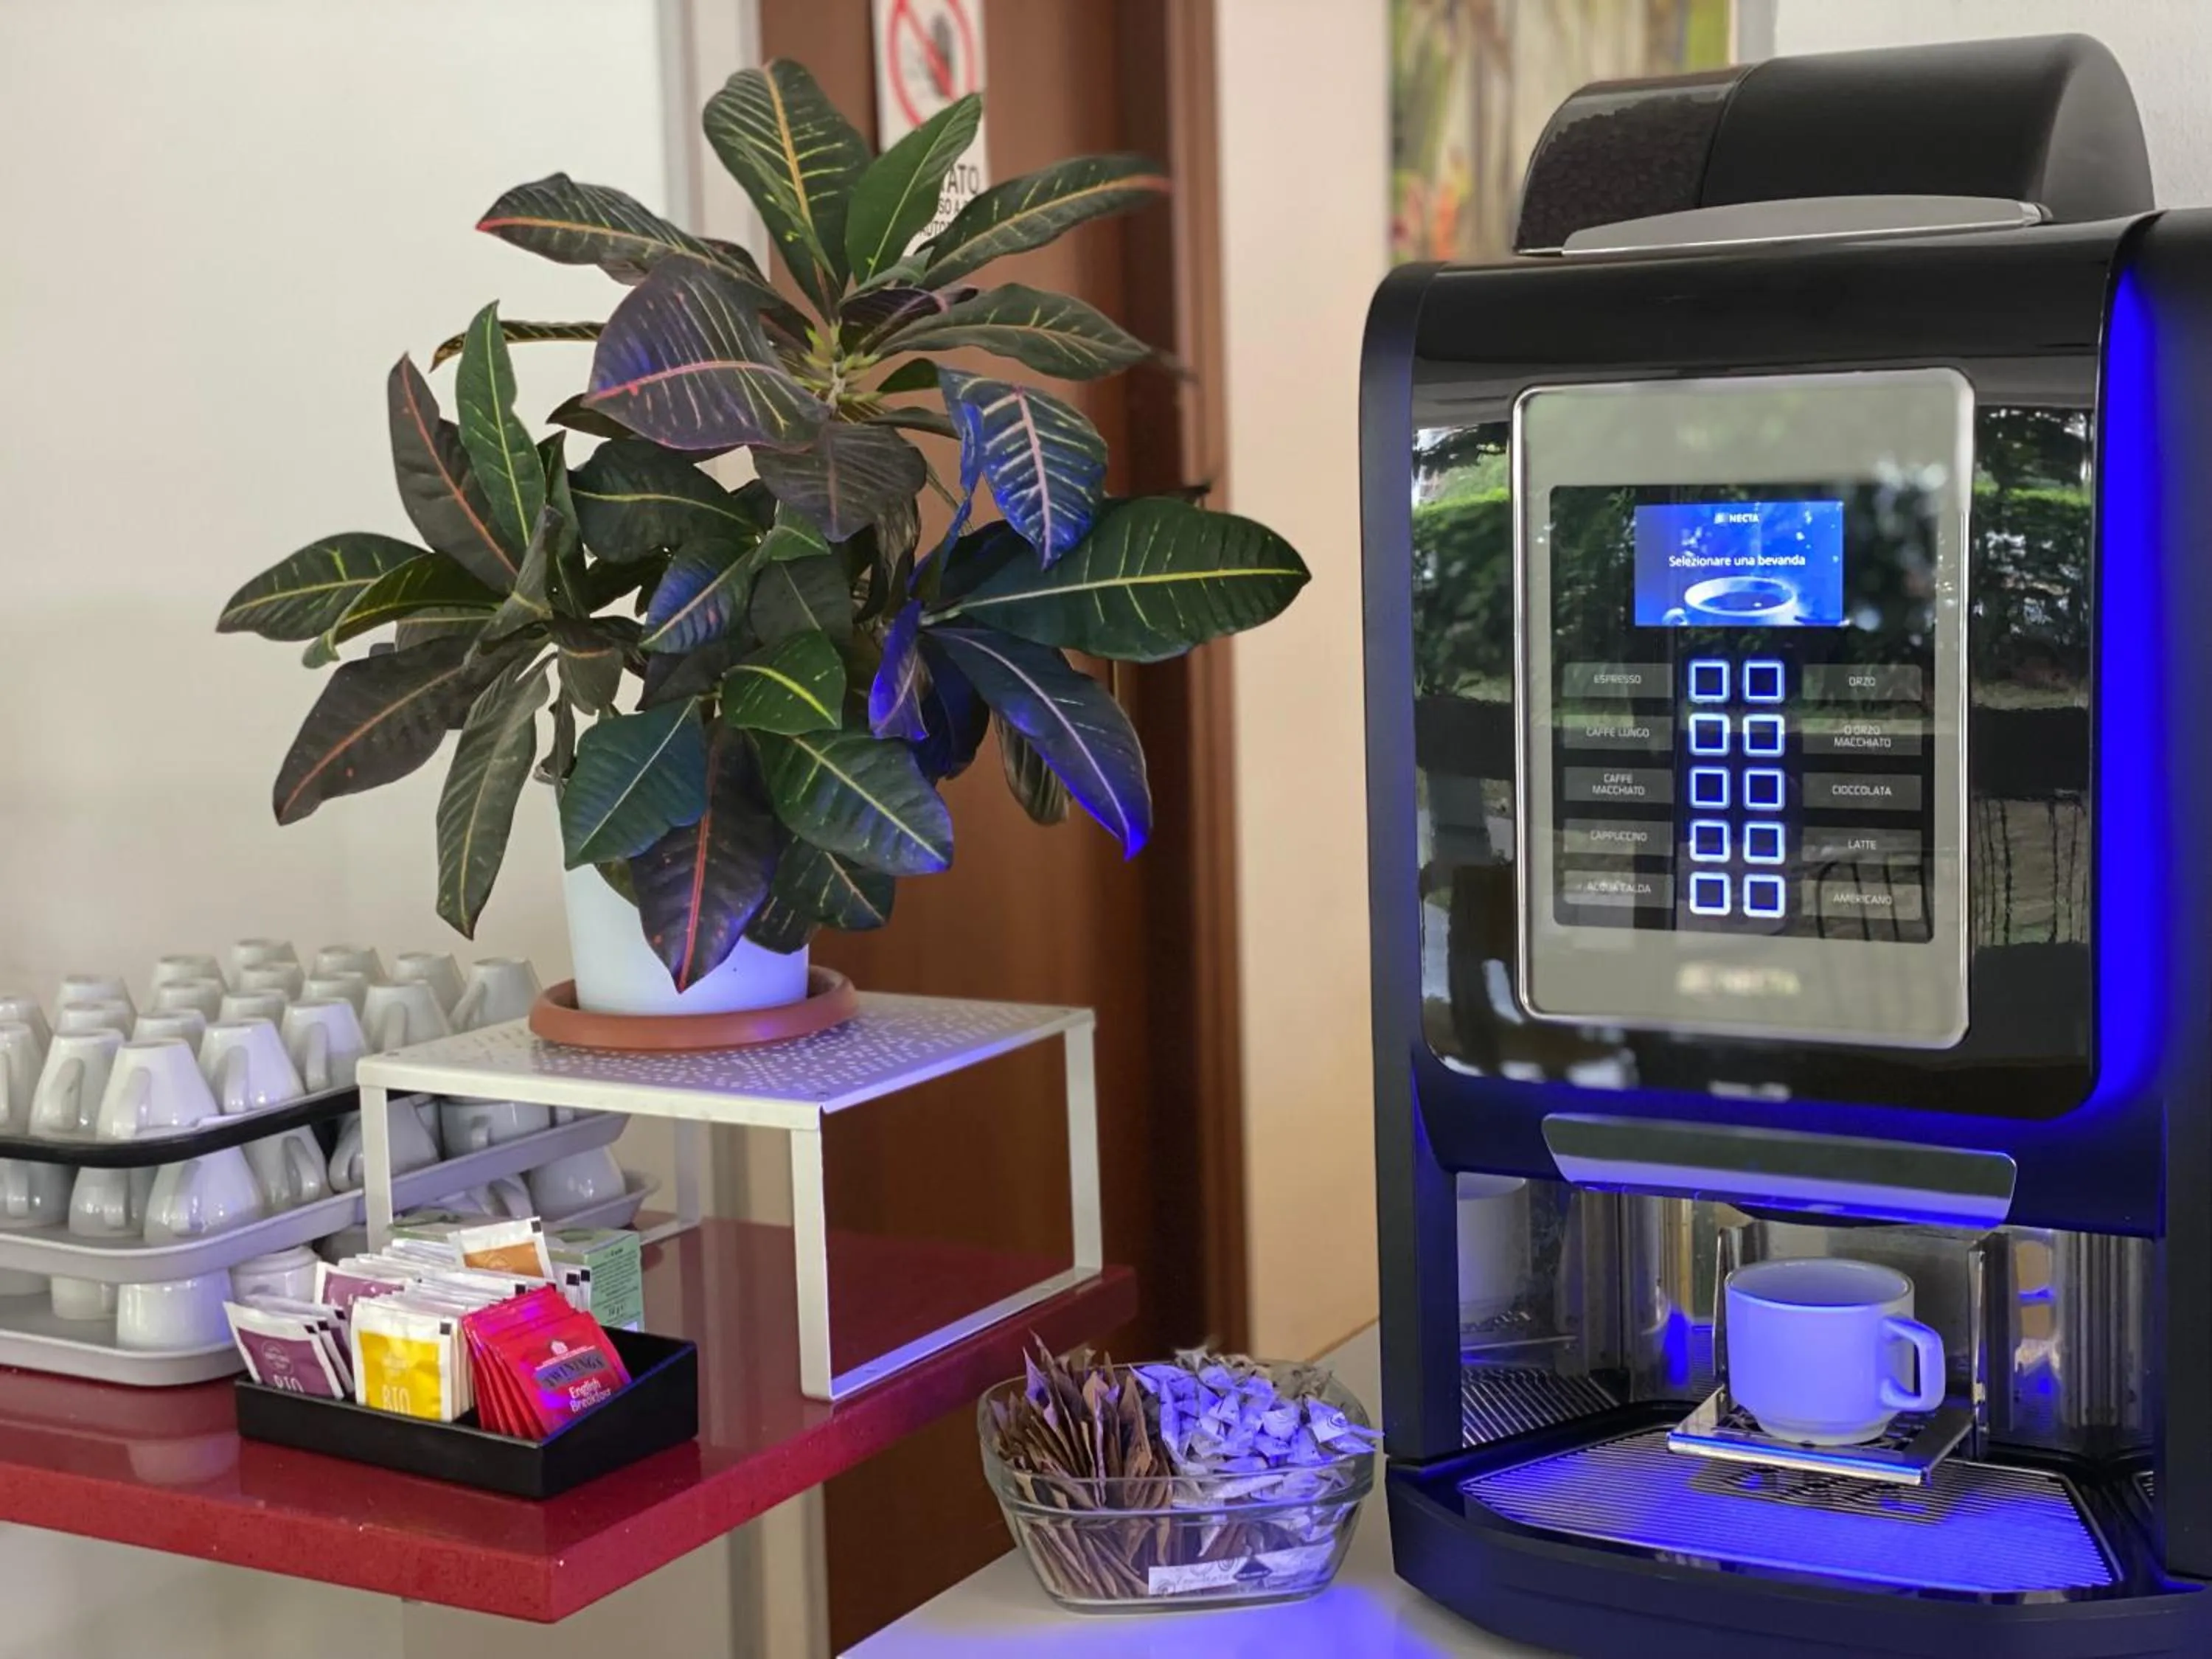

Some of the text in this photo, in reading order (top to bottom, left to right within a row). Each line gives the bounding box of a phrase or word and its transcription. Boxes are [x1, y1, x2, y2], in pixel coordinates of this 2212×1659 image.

[1729, 513, 1759, 523] NECTA
[1669, 554, 1806, 567] Selezionare una bevanda
[1593, 674, 1642, 684] ESPRESSO
[1848, 676, 1877, 686] ORZO
[1833, 737, 1892, 748] MACCHIATO
[1592, 785, 1646, 796] MACCHIATO
[1832, 785, 1893, 796] CIOCCOLATA
[1590, 830, 1647, 842] CAPPUCCINO
[1848, 838, 1877, 850] LATTE
[1833, 893, 1893, 905] AMERICANO
[546, 1356, 603, 1387] TWININGS
[568, 1377, 601, 1399] English
[382, 1384, 411, 1413] BIO
